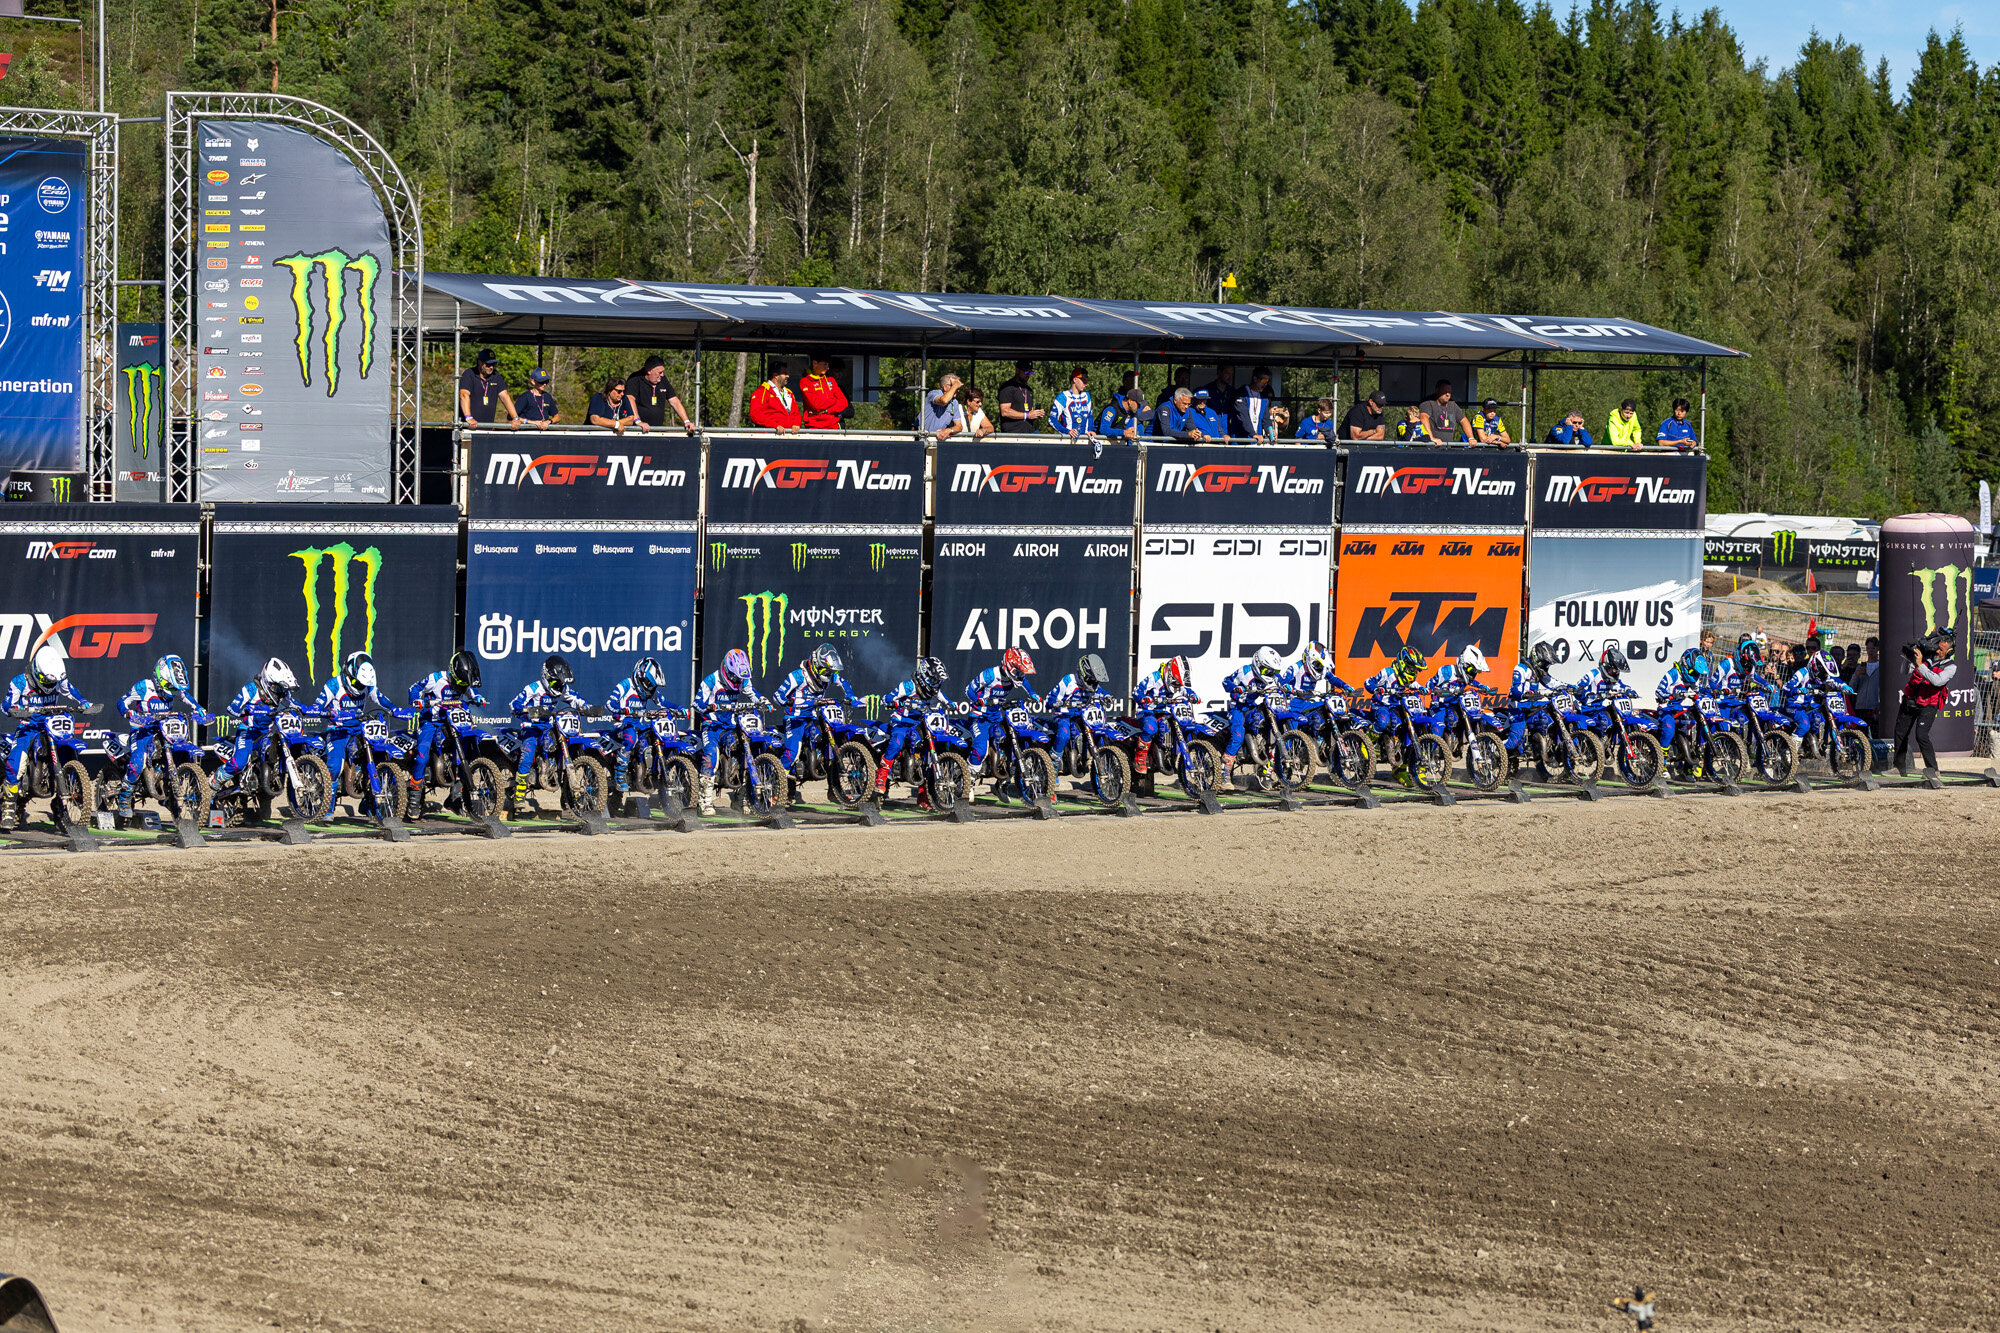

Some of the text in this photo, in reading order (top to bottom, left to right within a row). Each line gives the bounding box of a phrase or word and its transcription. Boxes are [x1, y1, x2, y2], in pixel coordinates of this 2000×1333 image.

[43, 231, 70, 240] YAMAHA
[33, 270, 72, 287] FIM
[129, 336, 159, 347] MXGP
[482, 546, 691, 554] Husqvarna Husqvarna Husqvarna Husqvarna
[940, 543, 1128, 557] AIROH AIROH AIROH
[1145, 538, 1327, 556] SIDI SIDI SIDI
[1343, 540, 1521, 556] KTM KTM KTM KTM
[1704, 542, 1762, 554] ONSTER
[1808, 544, 1876, 558] MONSTER
[1886, 542, 1926, 550] GINSENG
[886, 548, 918, 556] MONSTER
[790, 606, 884, 627] MONSTER
[1554, 600, 1674, 627] FOLLOW US
[956, 608, 1107, 650] AIROH
[1150, 602, 1320, 658] SIDI
[1348, 592, 1508, 658] KTM
[516, 620, 682, 658] Husqvarna
[804, 630, 870, 638] ENERGY
[1268, 697, 1286, 706] 782
[1332, 700, 1344, 708] 14
[1407, 700, 1422, 709] 981
[1464, 698, 1479, 708] 515
[1620, 701, 1630, 711] 119
[1829, 701, 1844, 710] 426
[451, 712, 472, 723] 683
[827, 709, 842, 719] 112
[1012, 712, 1027, 722] 83
[1087, 711, 1102, 721] 414
[1176, 708, 1192, 717] 465
[52, 720, 71, 730] 26
[281, 719, 300, 730] 244
[476, 716, 512, 724] Husqvarna
[562, 719, 579, 729] 719
[746, 718, 758, 728] 3
[930, 717, 944, 727] 41
[1206, 718, 1225, 730] 782
[166, 724, 186, 734] 121
[366, 724, 387, 736] 378
[657, 722, 674, 734] 141
[1114, 724, 1131, 736] 465
[394, 737, 412, 750] 683
[216, 744, 234, 757] 244
